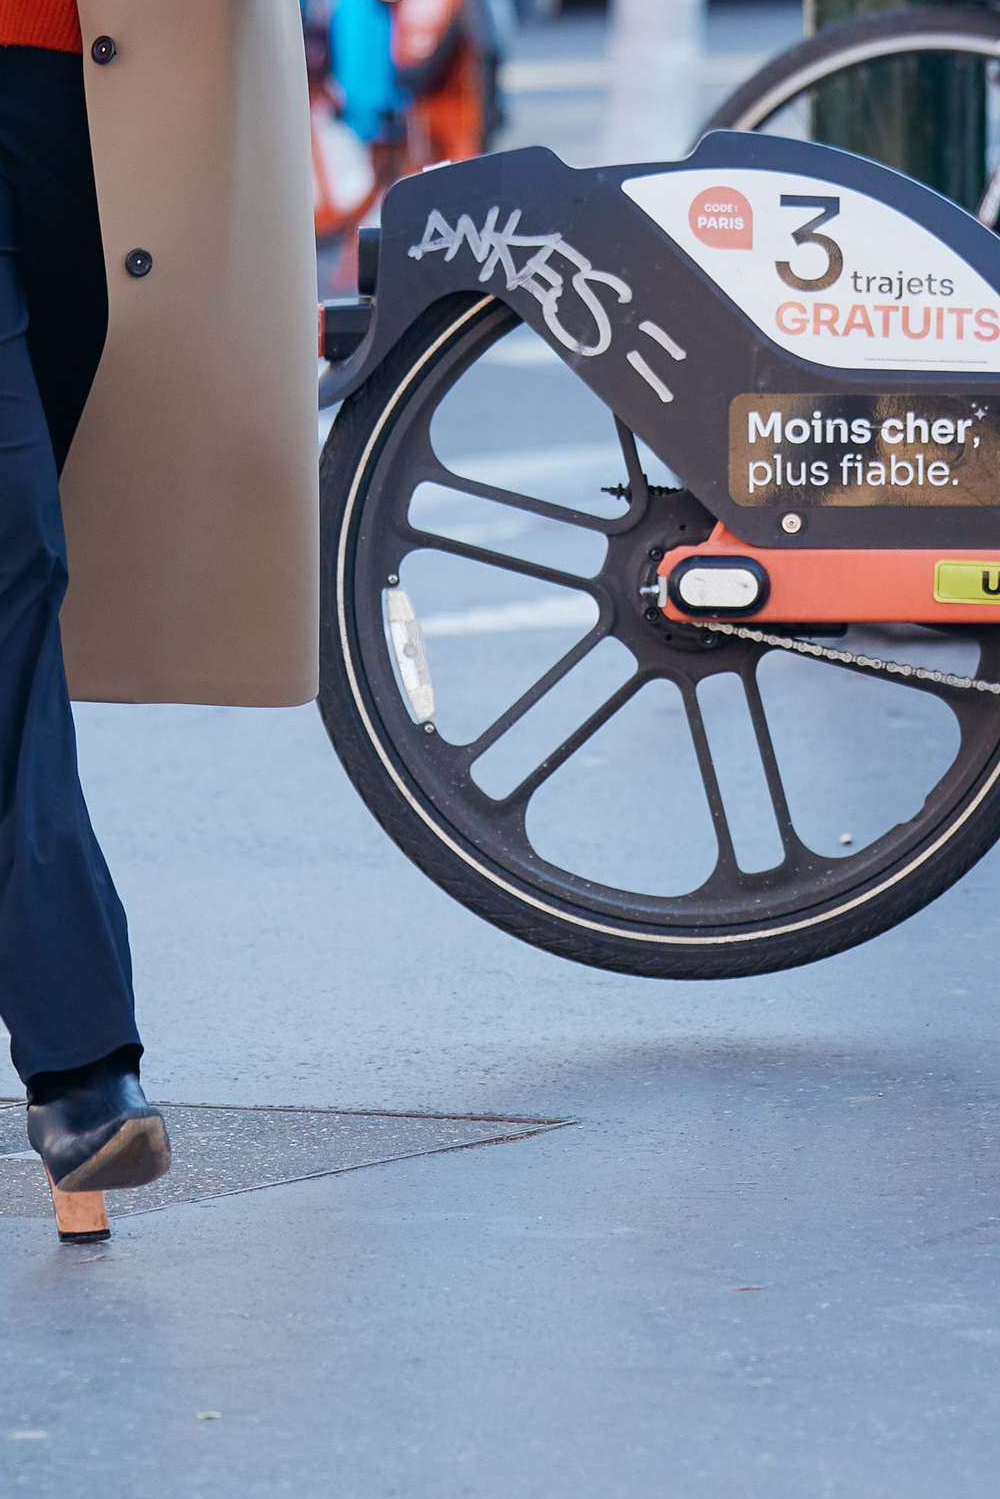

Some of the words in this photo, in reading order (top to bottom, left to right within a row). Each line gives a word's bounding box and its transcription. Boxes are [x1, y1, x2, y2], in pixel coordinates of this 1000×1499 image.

[697, 216, 744, 230] PARIS
[775, 194, 844, 292] 3
[851, 271, 954, 300] trajets
[775, 301, 1000, 343] GRATUITS
[748, 410, 872, 445] Moins
[880, 411, 981, 449] cher,
[748, 454, 830, 494] plus
[840, 453, 959, 487] fiable.
